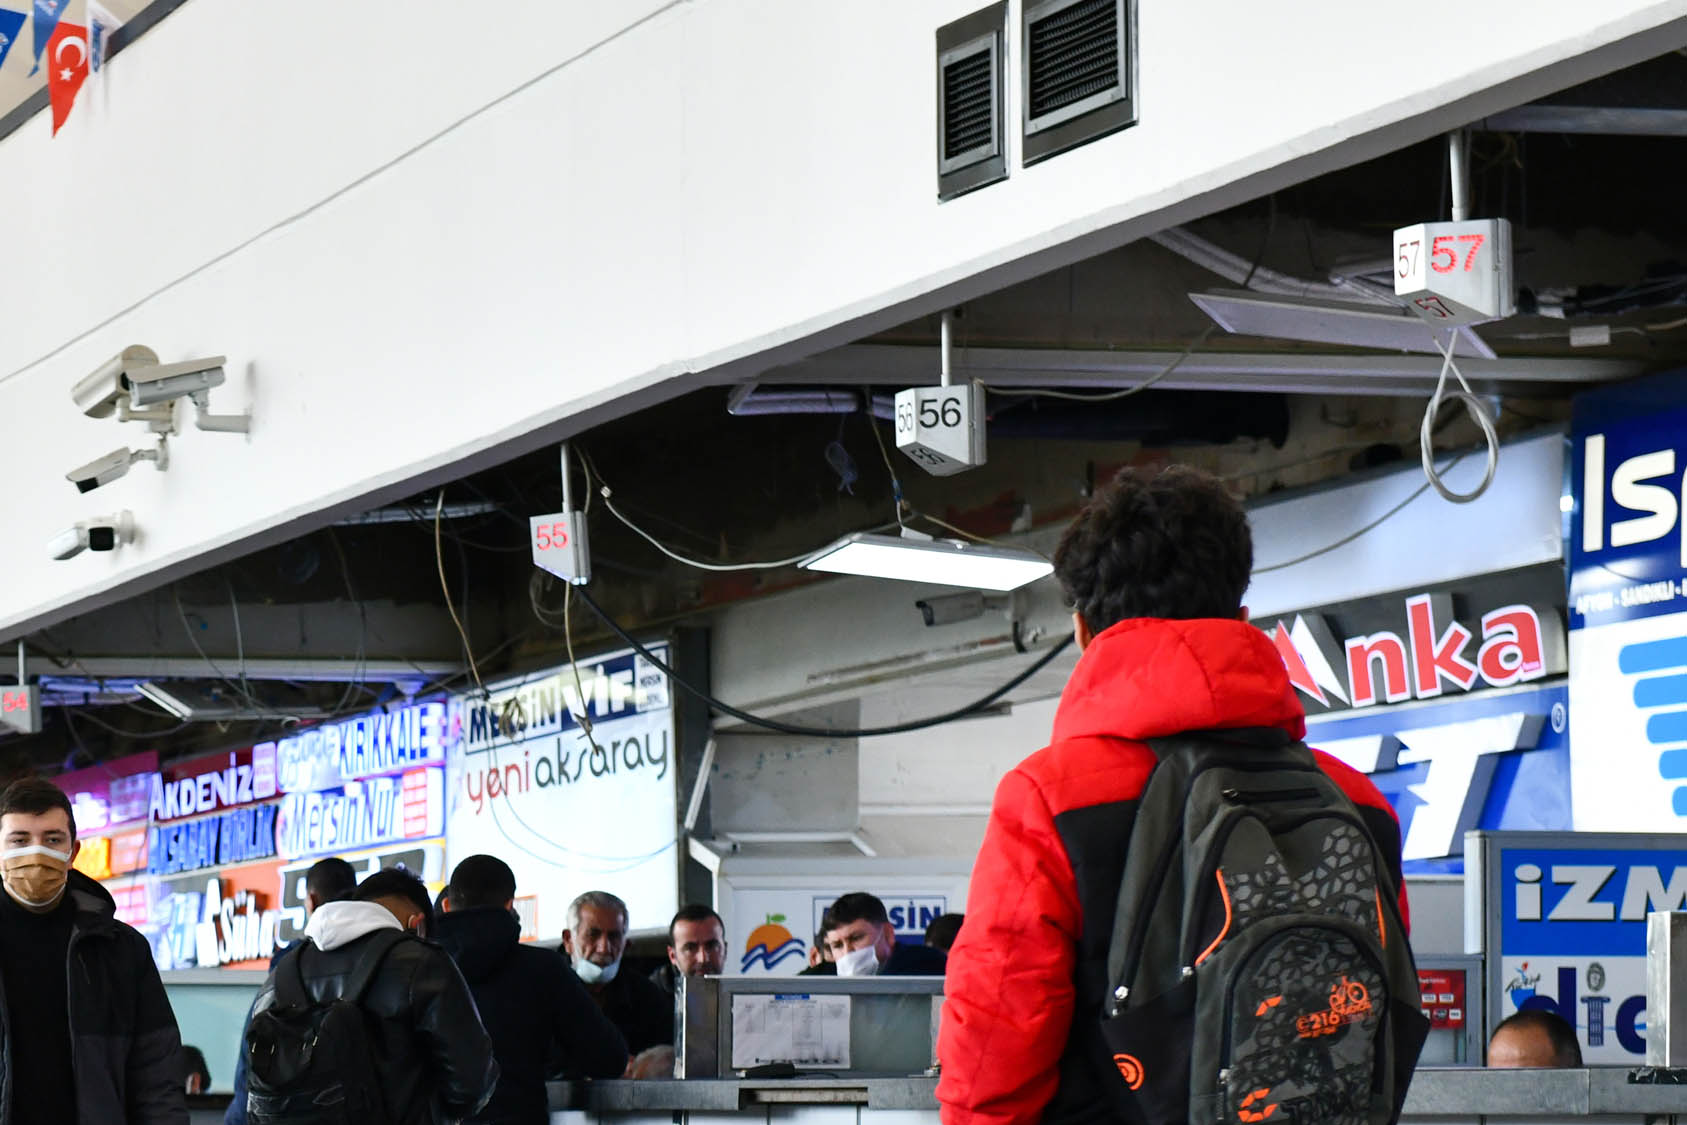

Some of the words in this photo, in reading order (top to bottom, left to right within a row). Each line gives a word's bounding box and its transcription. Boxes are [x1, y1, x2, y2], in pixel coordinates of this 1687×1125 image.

[1398, 240, 1420, 279] 57
[1431, 234, 1486, 274] 57
[898, 402, 913, 433] 56
[919, 397, 961, 428] 56
[1583, 433, 1687, 570] Is
[535, 521, 570, 551] 55
[2, 692, 28, 713] 54
[340, 703, 431, 777] KIRIKKALE
[148, 751, 256, 823] AKDENİZ
[467, 750, 530, 815] yeni
[534, 730, 668, 788] aksaray
